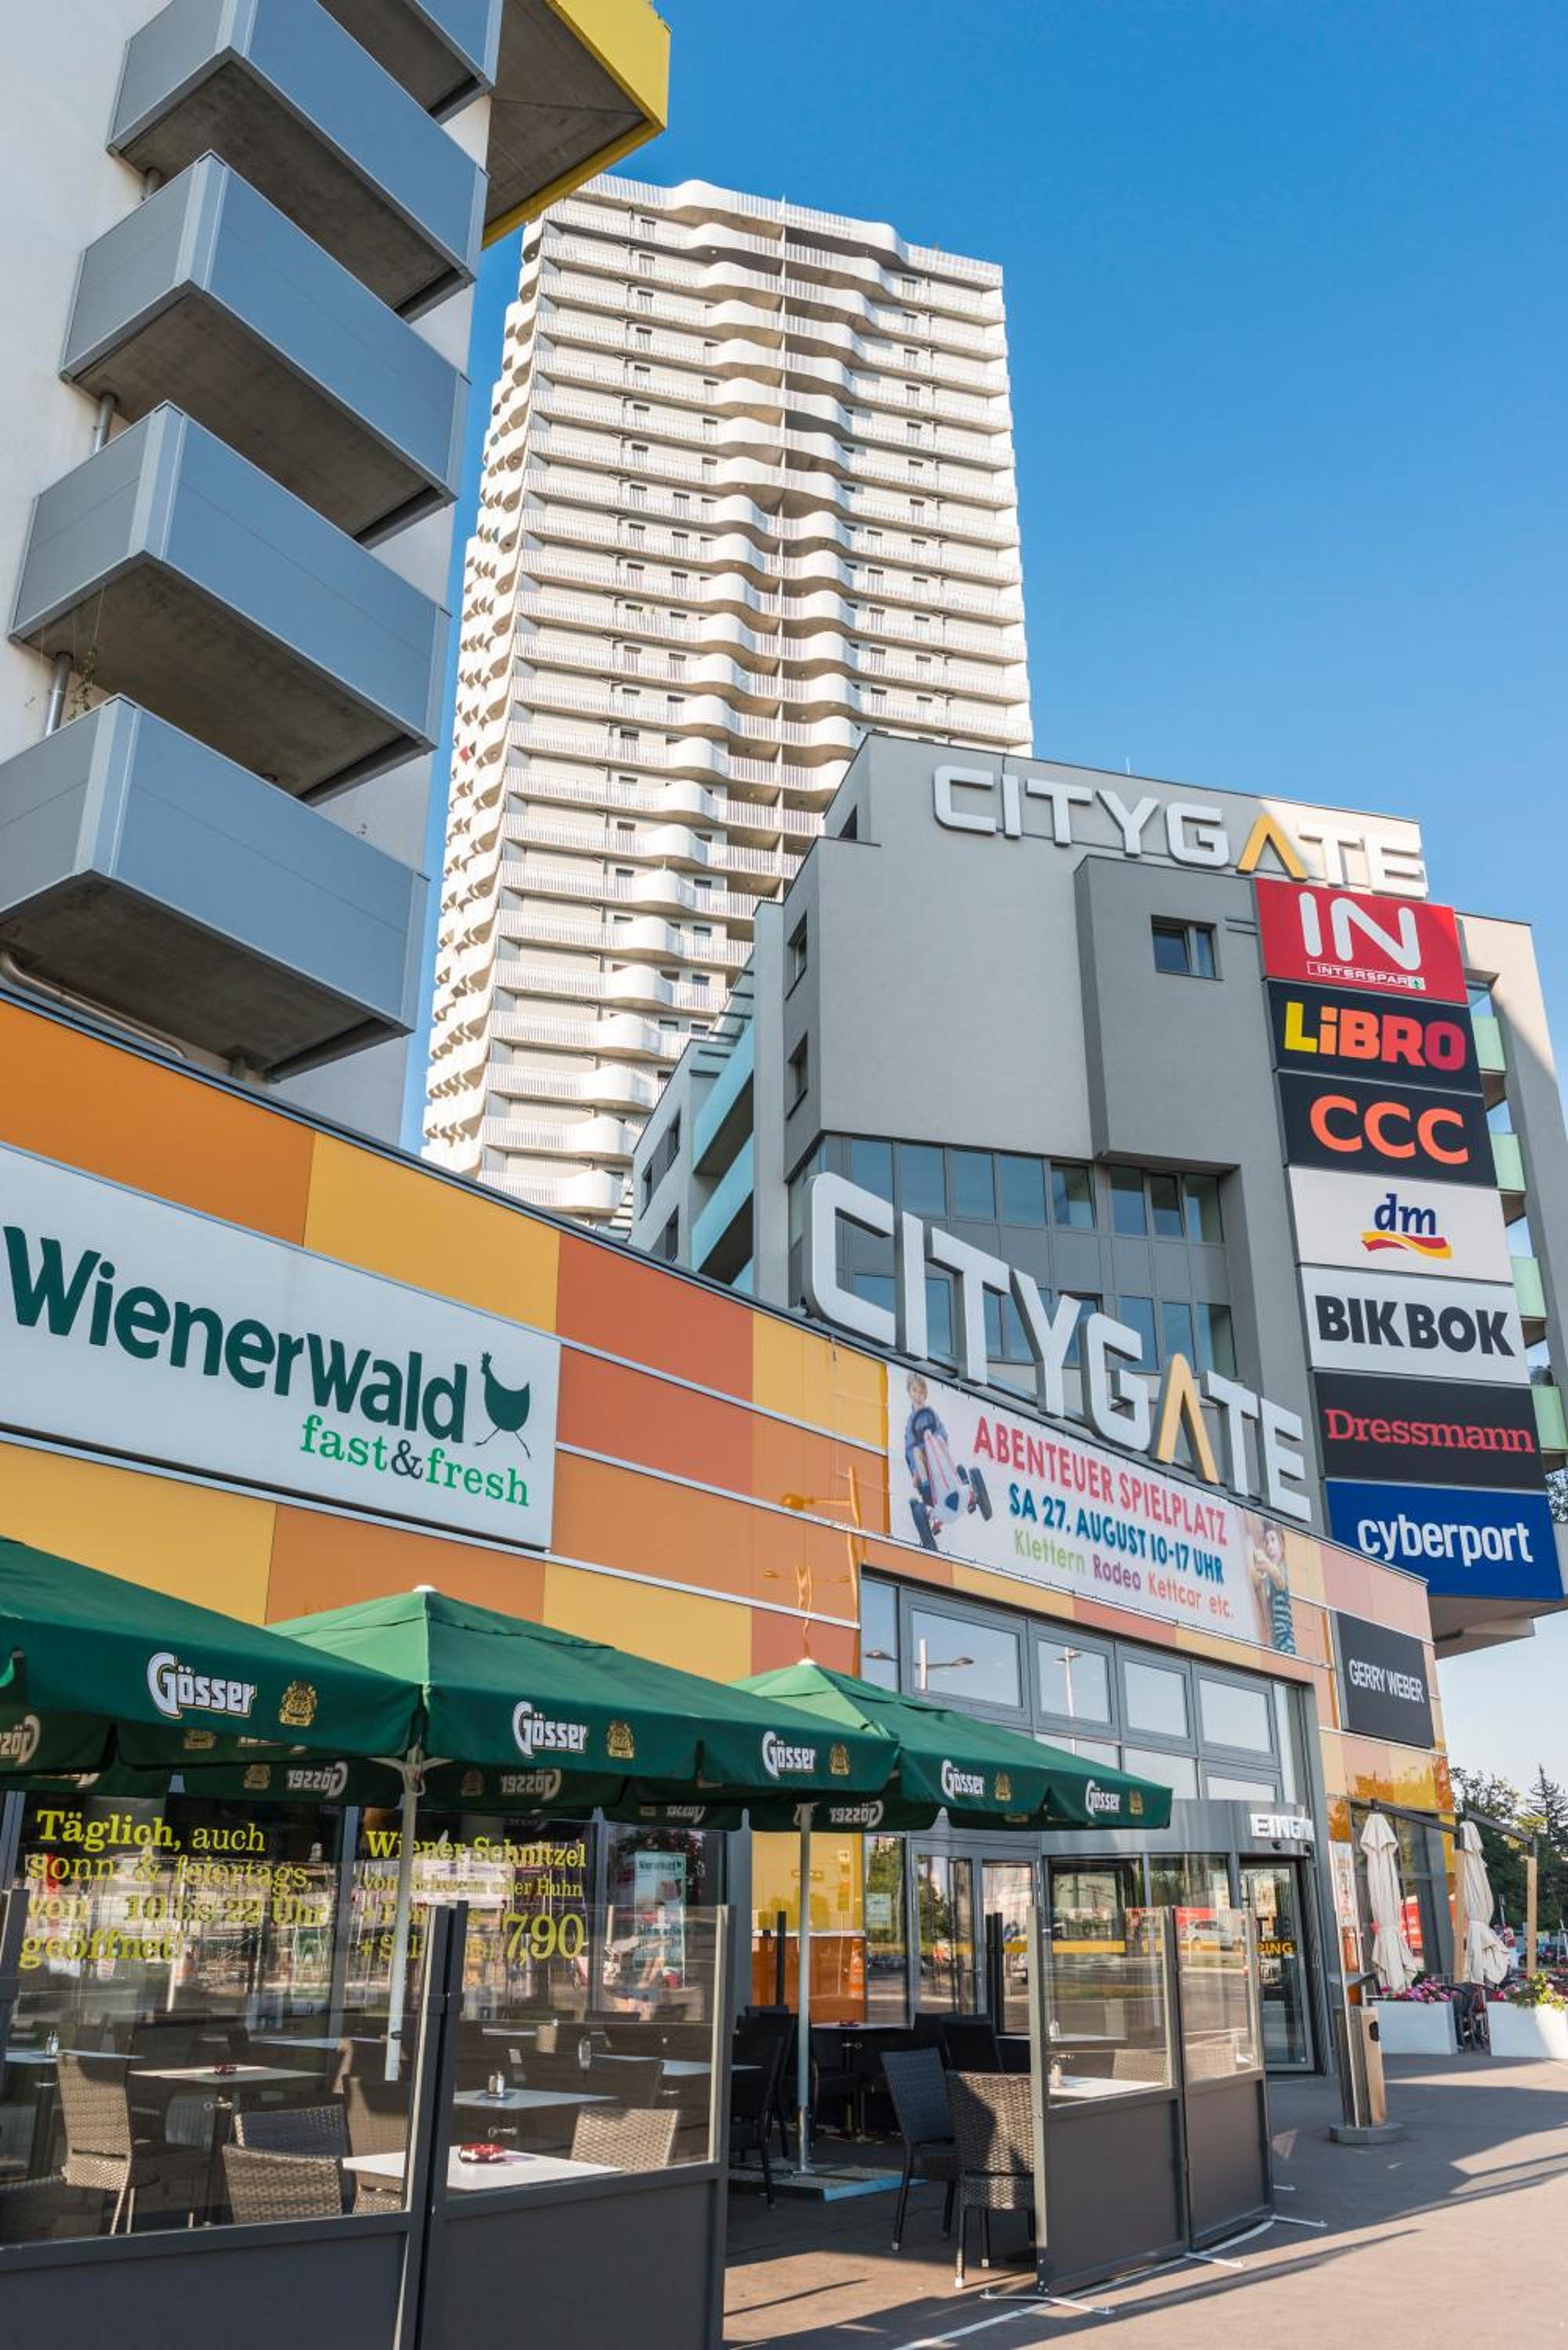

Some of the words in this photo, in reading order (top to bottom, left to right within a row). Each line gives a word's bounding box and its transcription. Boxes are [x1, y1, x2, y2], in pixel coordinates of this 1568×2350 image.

[933, 765, 1428, 900] CITYGATE
[1299, 891, 1422, 971] IN
[1317, 964, 1410, 986] INTERSPAR
[1310, 1094, 1469, 1166] CCC
[1374, 1193, 1436, 1236] dm
[804, 1171, 1312, 1523] CITYGATE
[1324, 1408, 1536, 1454] Dressmann
[973, 1415, 1115, 1504] ABENTEUER
[1118, 1471, 1227, 1546] SPIELPLATZ
[1009, 1483, 1037, 1522] SA
[1042, 1495, 1071, 1532] 27.
[1076, 1507, 1146, 1558] AUGUST
[1193, 1547, 1225, 1585] UHR
[1357, 1513, 1535, 1567] cyberport
[1014, 1528, 1086, 1575] Klettern
[1092, 1553, 1141, 1592] Rodeo
[1147, 1572, 1202, 1612] Kettcar
[1208, 1595, 1234, 1618] etc.
[146, 1650, 258, 1719] Gösser
[1349, 1658, 1385, 1693] GERRY
[1386, 1668, 1425, 1704] WEBER
[511, 1700, 589, 1759] Gösser
[761, 1730, 816, 1779] Gösser
[941, 1759, 986, 1801] Gösser
[1085, 1778, 1122, 1816] Gösser
[36, 1810, 181, 1853] Täglich,
[192, 1823, 266, 1852] auch
[473, 1835, 587, 1868] Schnitzel
[537, 1878, 583, 1896] Huhn
